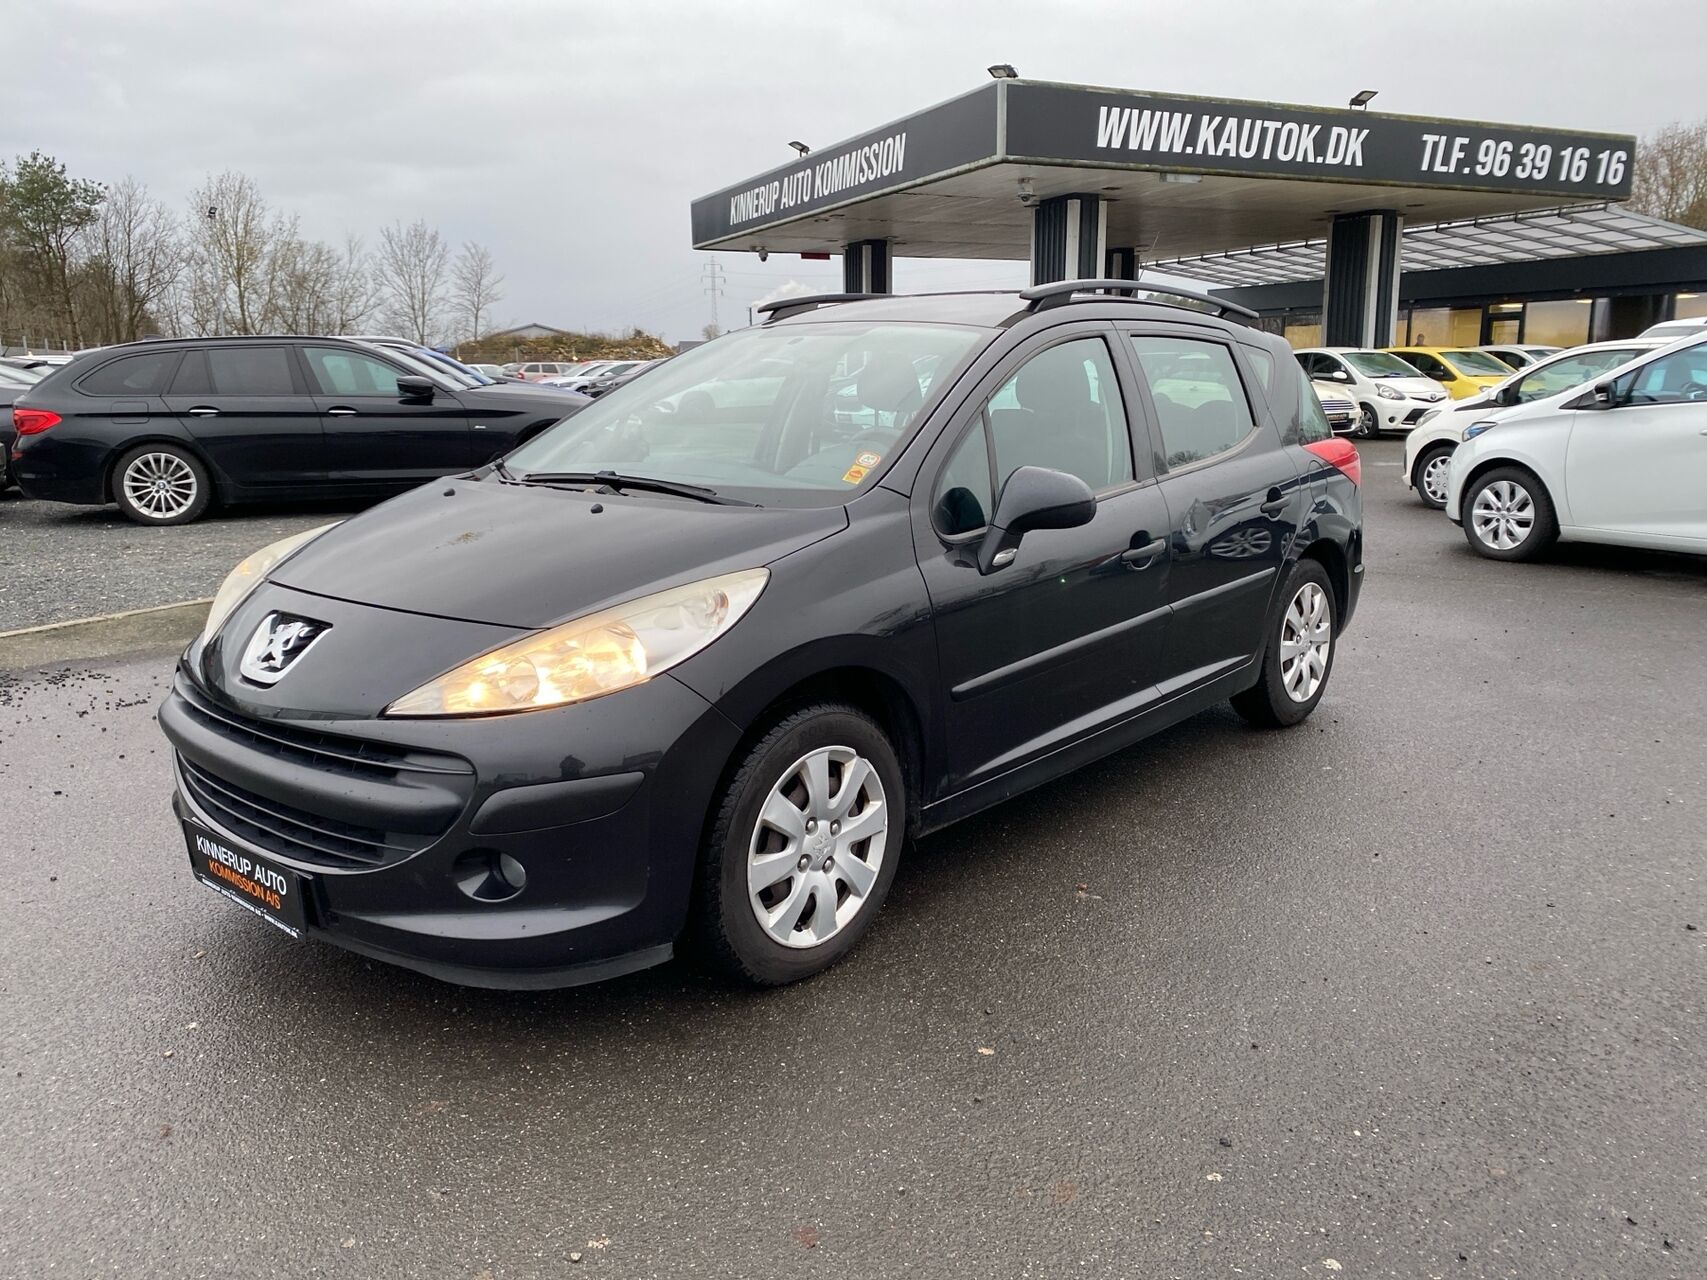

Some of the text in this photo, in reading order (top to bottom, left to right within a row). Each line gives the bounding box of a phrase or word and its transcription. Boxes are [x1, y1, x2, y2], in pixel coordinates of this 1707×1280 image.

[1097, 106, 1370, 167] WWW.KAUTOK.DK
[1475, 138, 1514, 177] 96
[1515, 142, 1553, 180] 39
[1558, 146, 1590, 183] 16
[1596, 150, 1628, 186] 16
[730, 133, 907, 225] KINNERUP AUTO KOMMISSION
[196, 834, 287, 896] KINNERUP AUTO
[208, 859, 265, 900] KOMMISSION
[266, 889, 281, 910] A/S
